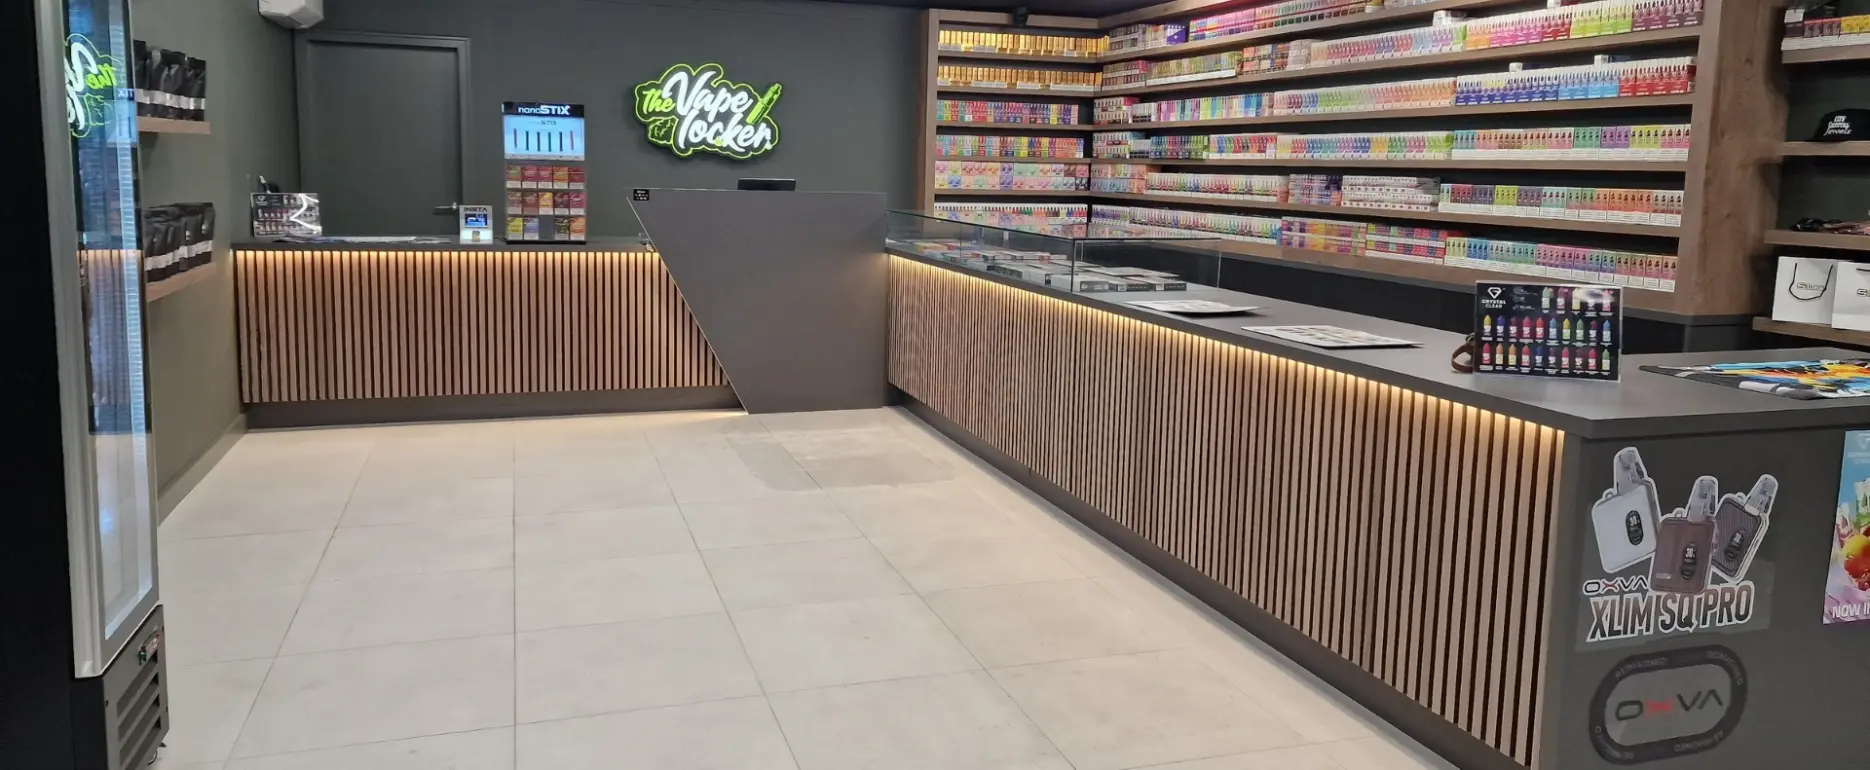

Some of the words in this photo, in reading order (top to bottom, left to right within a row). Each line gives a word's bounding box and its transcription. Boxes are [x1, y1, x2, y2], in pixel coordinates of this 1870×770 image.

[662, 71, 753, 122] Vape
[1584, 576, 1649, 593] OXVA
[1590, 594, 1651, 639] XLIM
[1660, 592, 1696, 632] SQ
[1702, 584, 1751, 626] PRO
[1832, 603, 1861, 618] NOW
[1614, 689, 1724, 721] OXVA
